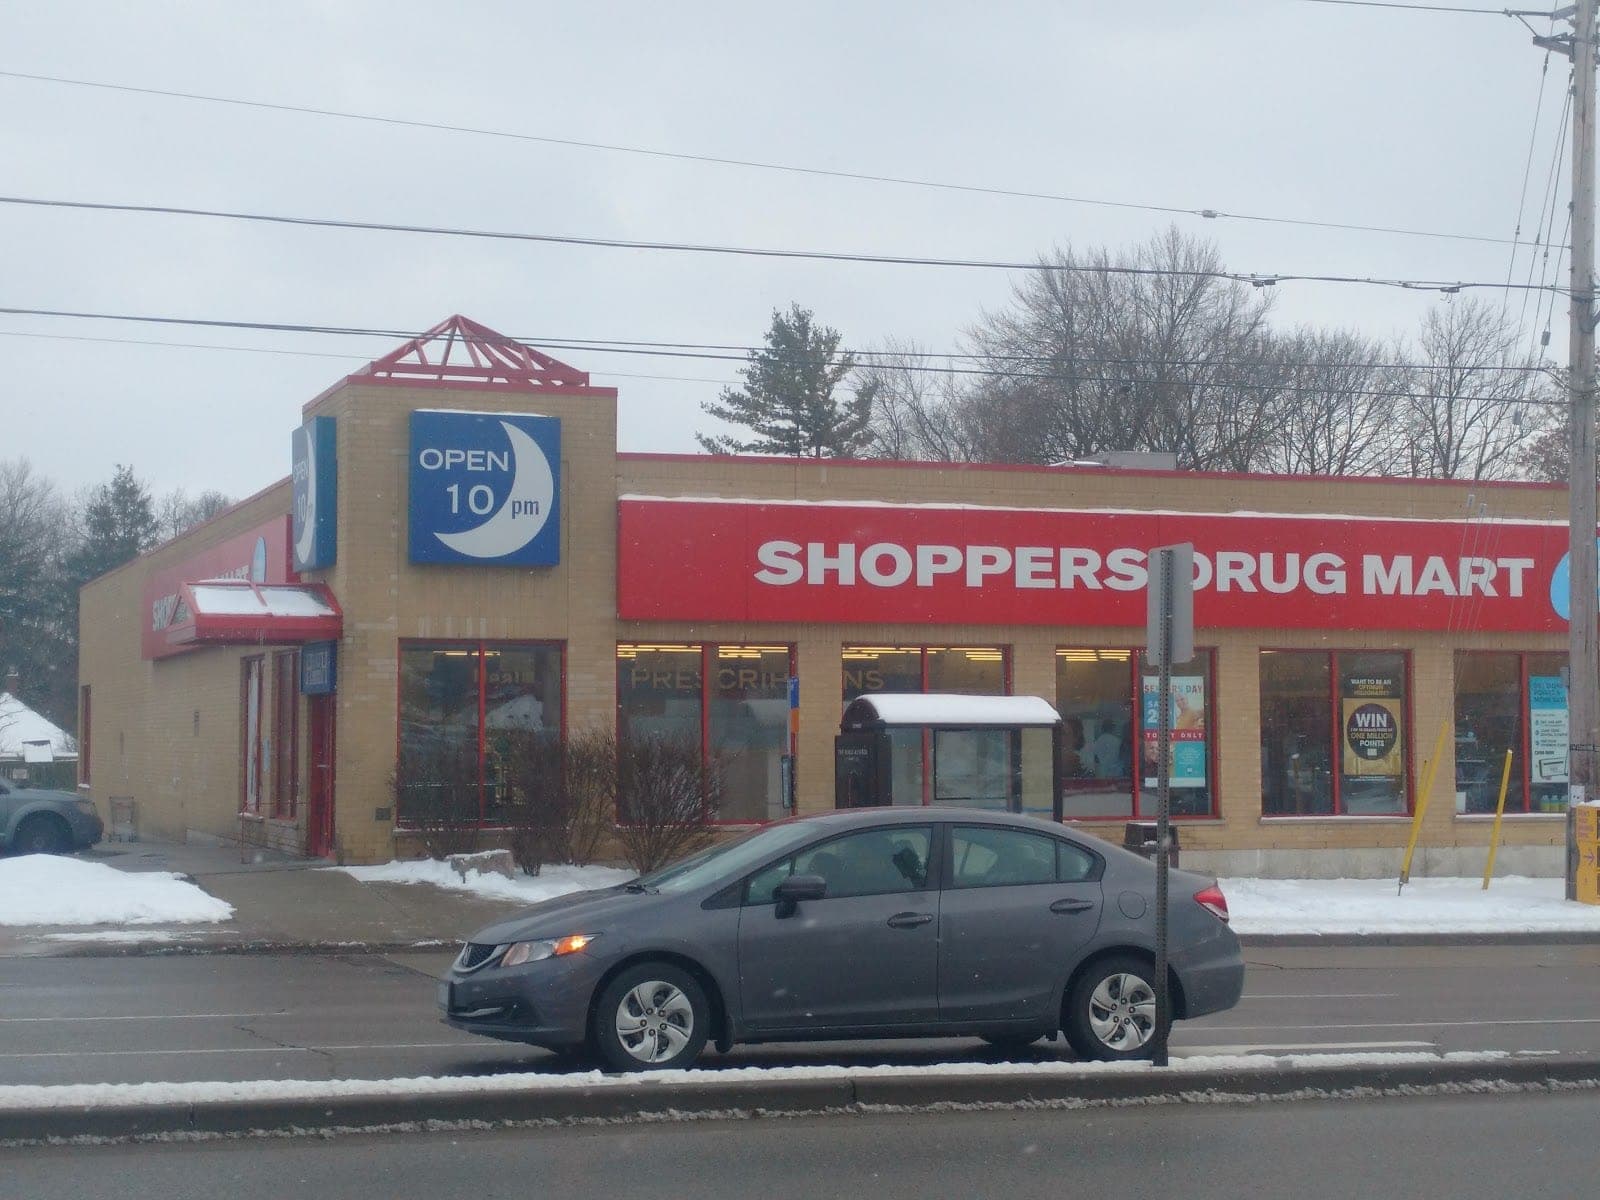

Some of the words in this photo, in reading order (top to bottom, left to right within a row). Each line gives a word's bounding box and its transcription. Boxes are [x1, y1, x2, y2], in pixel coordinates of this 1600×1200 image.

[419, 448, 509, 472] OPEN
[446, 483, 494, 515] 10
[511, 500, 540, 519] pm
[753, 540, 1149, 591] SHOPPERS
[1362, 554, 1534, 597] MART
[1185, 684, 1203, 694] DAY
[1355, 713, 1388, 728] WIN
[1146, 731, 1176, 739] TOY
[1180, 731, 1203, 739] ONLY
[1359, 739, 1385, 747] POINTS
